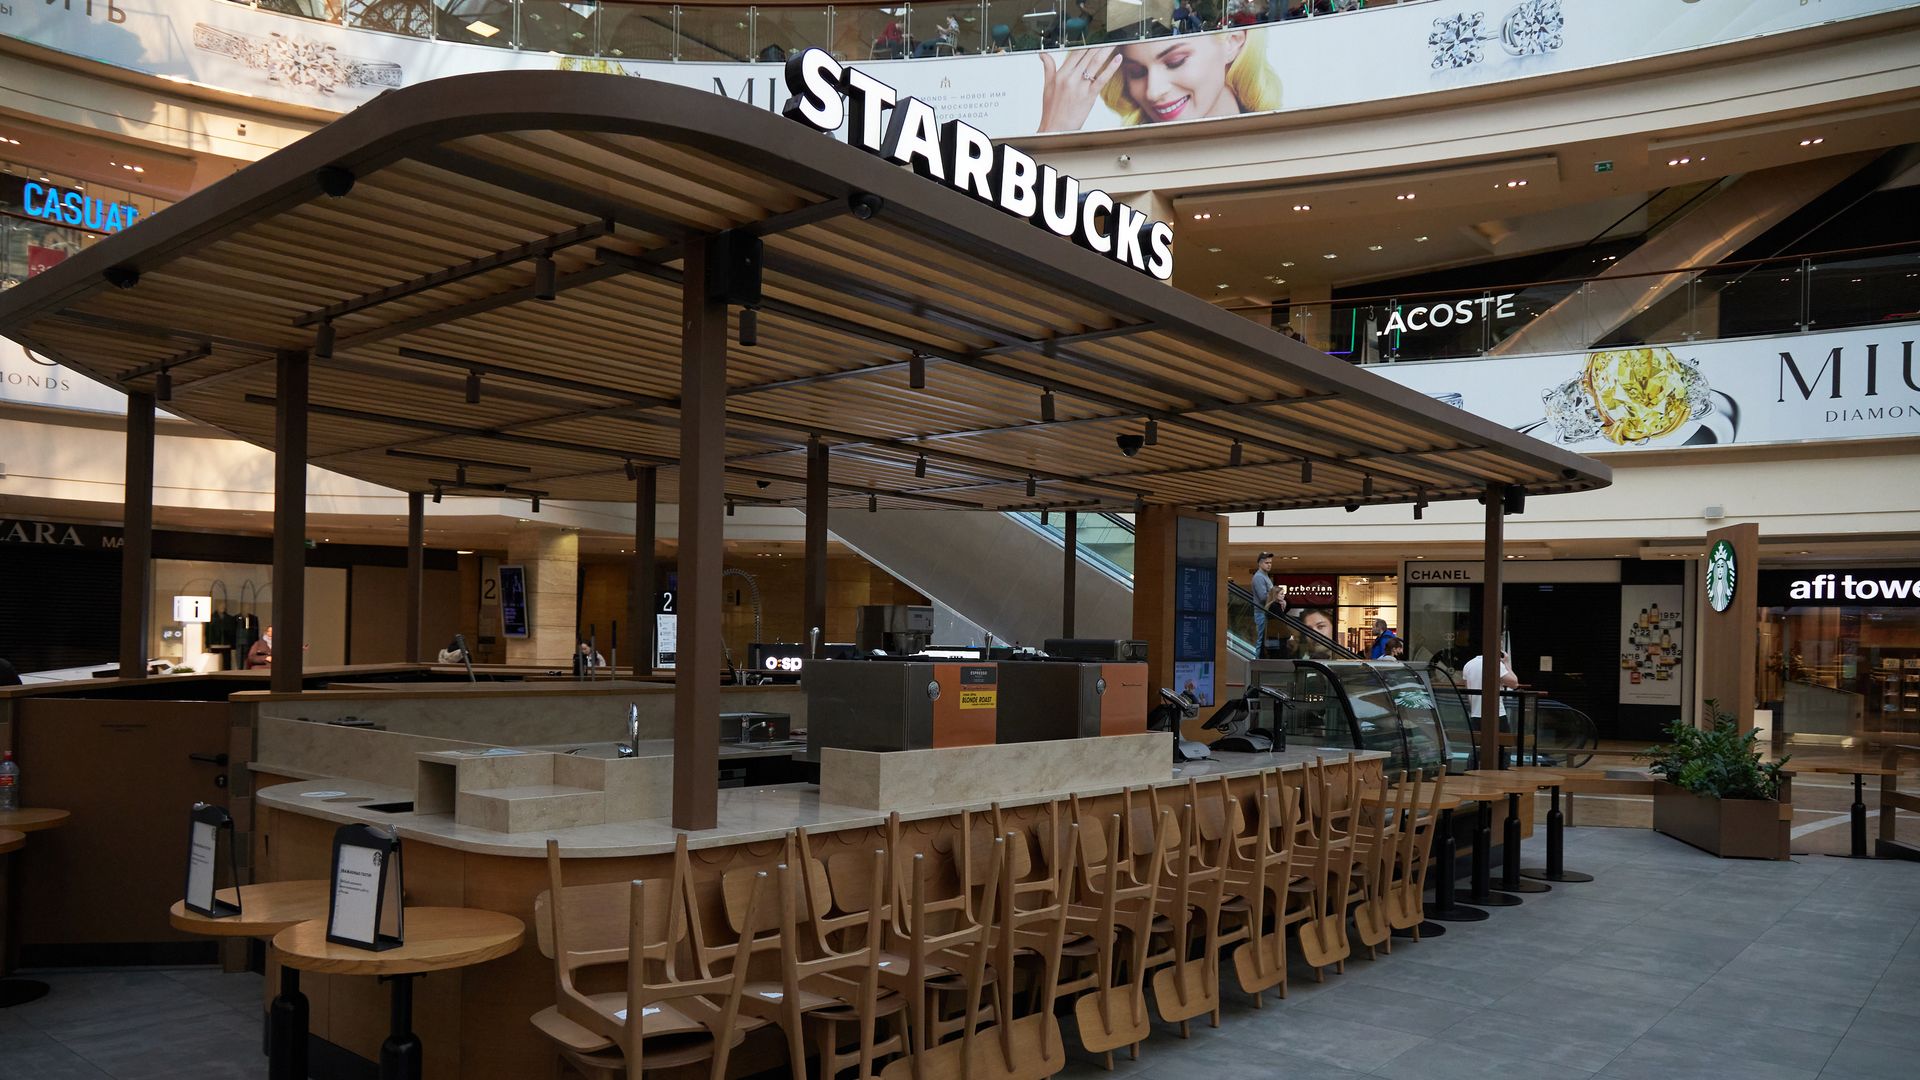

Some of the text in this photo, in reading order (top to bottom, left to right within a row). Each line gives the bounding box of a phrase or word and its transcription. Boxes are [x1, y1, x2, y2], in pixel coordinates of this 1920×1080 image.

[788, 46, 1174, 281] STARBUCKS
[1376, 293, 1516, 337] ACOSTE
[0, 371, 70, 391] ONDS
[1411, 570, 1471, 580] CHANEL
[484, 578, 496, 600] 2
[1289, 584, 1333, 592] erborian
[1789, 574, 1836, 599] afi
[663, 592, 673, 612] 2
